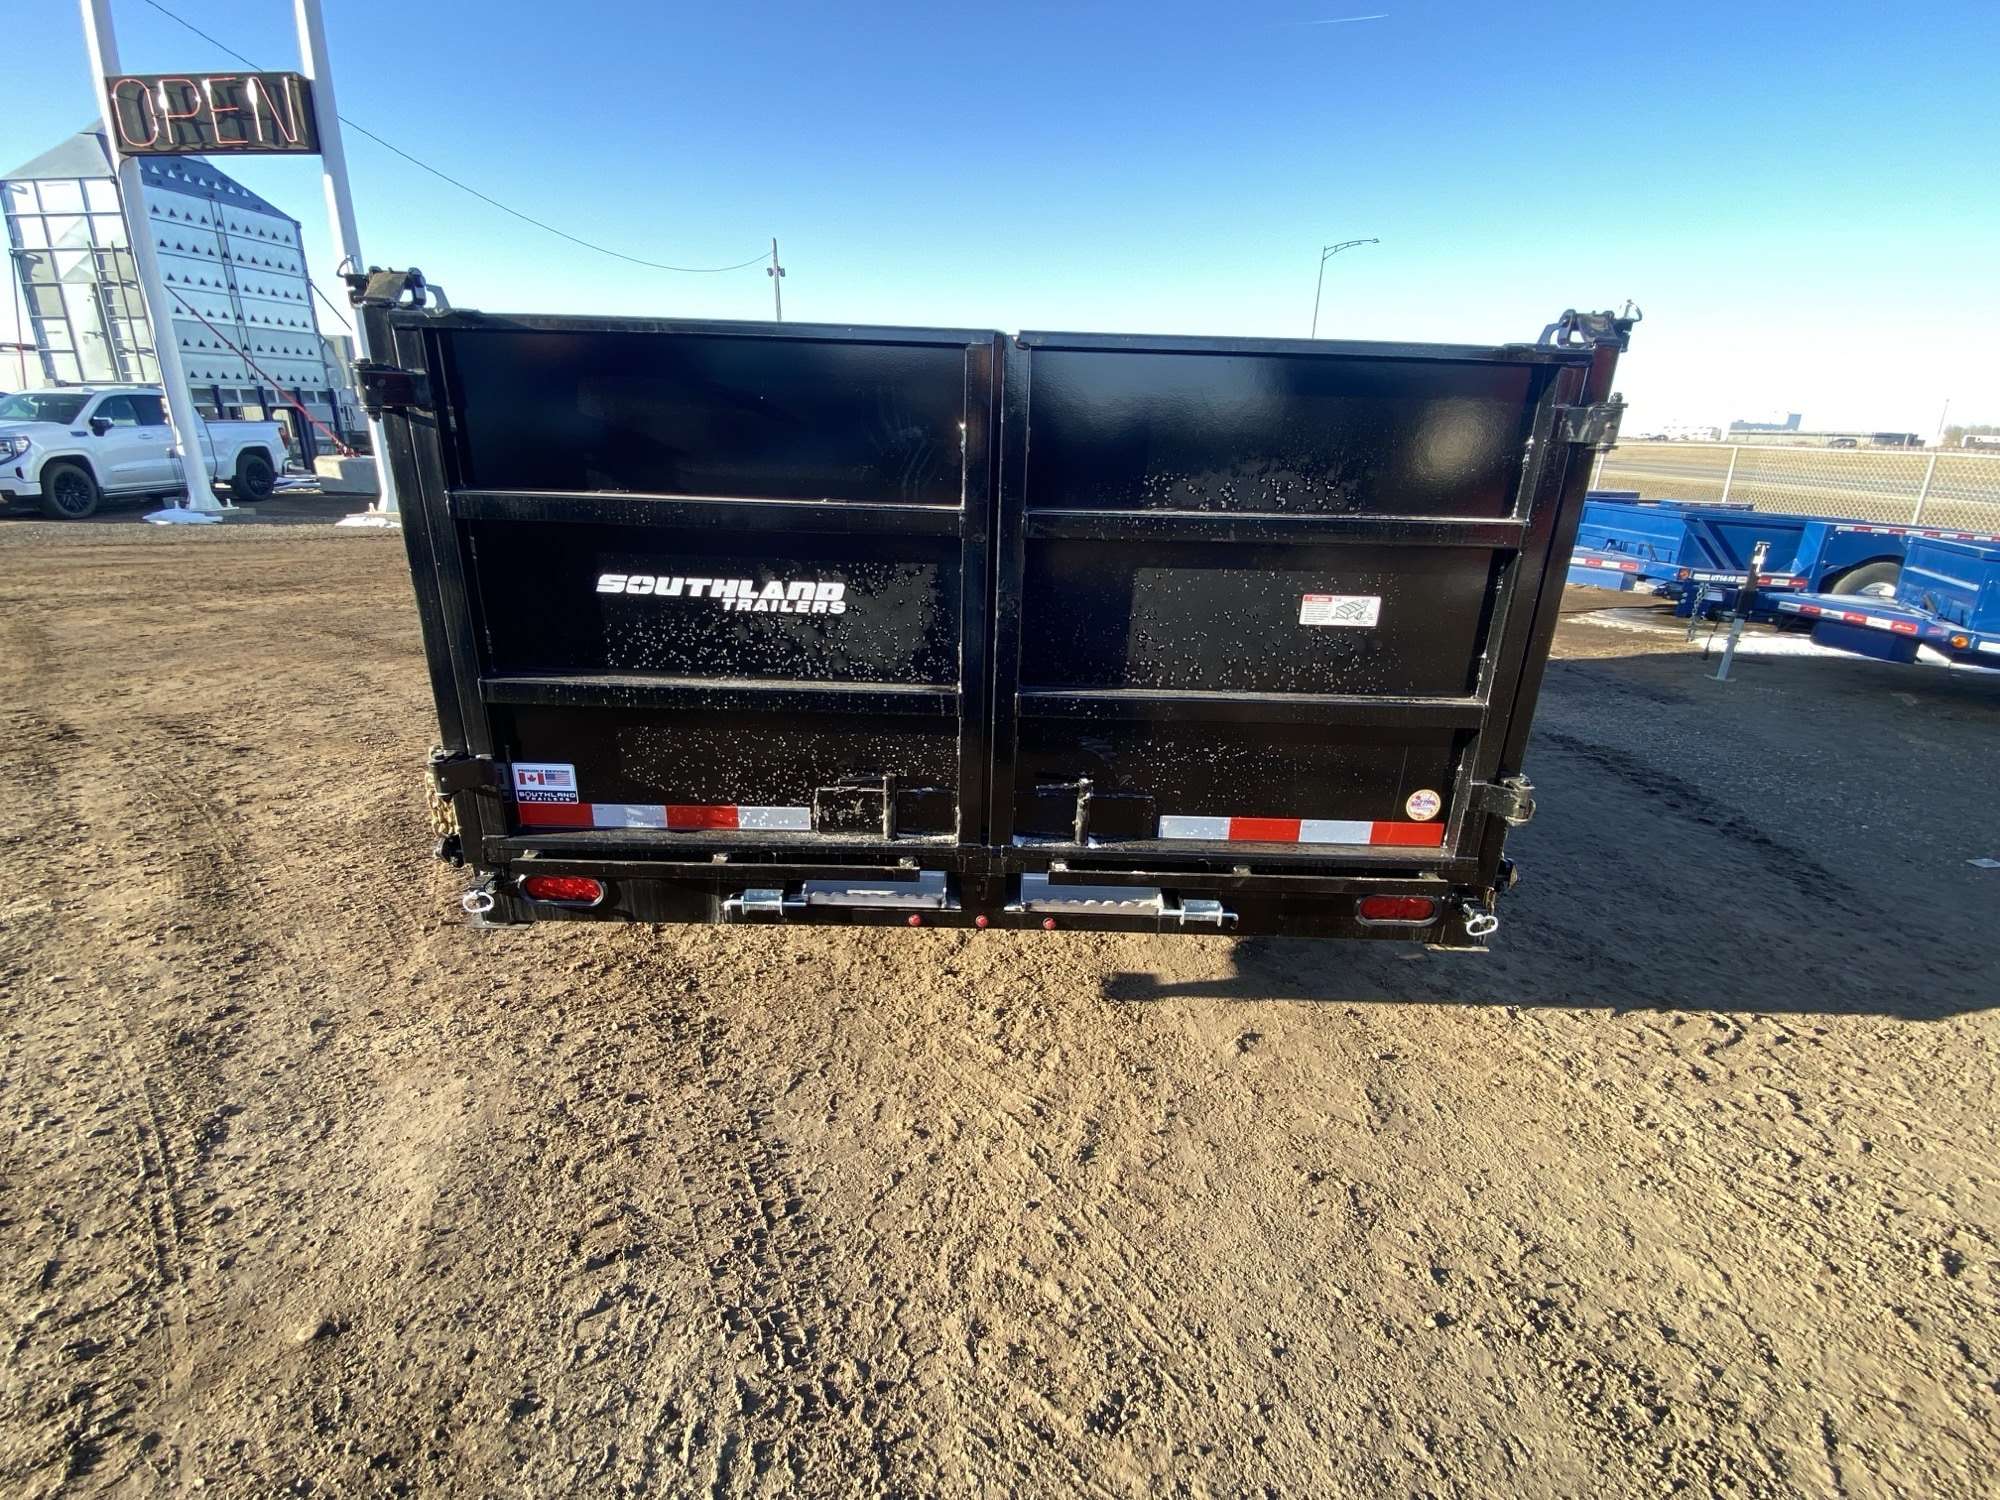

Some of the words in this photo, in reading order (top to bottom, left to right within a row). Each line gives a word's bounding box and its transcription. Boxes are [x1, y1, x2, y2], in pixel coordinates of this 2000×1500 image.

[112, 77, 298, 147] OPEN
[596, 574, 846, 601] SOUTHLAND
[722, 598, 847, 614] TRAILERS
